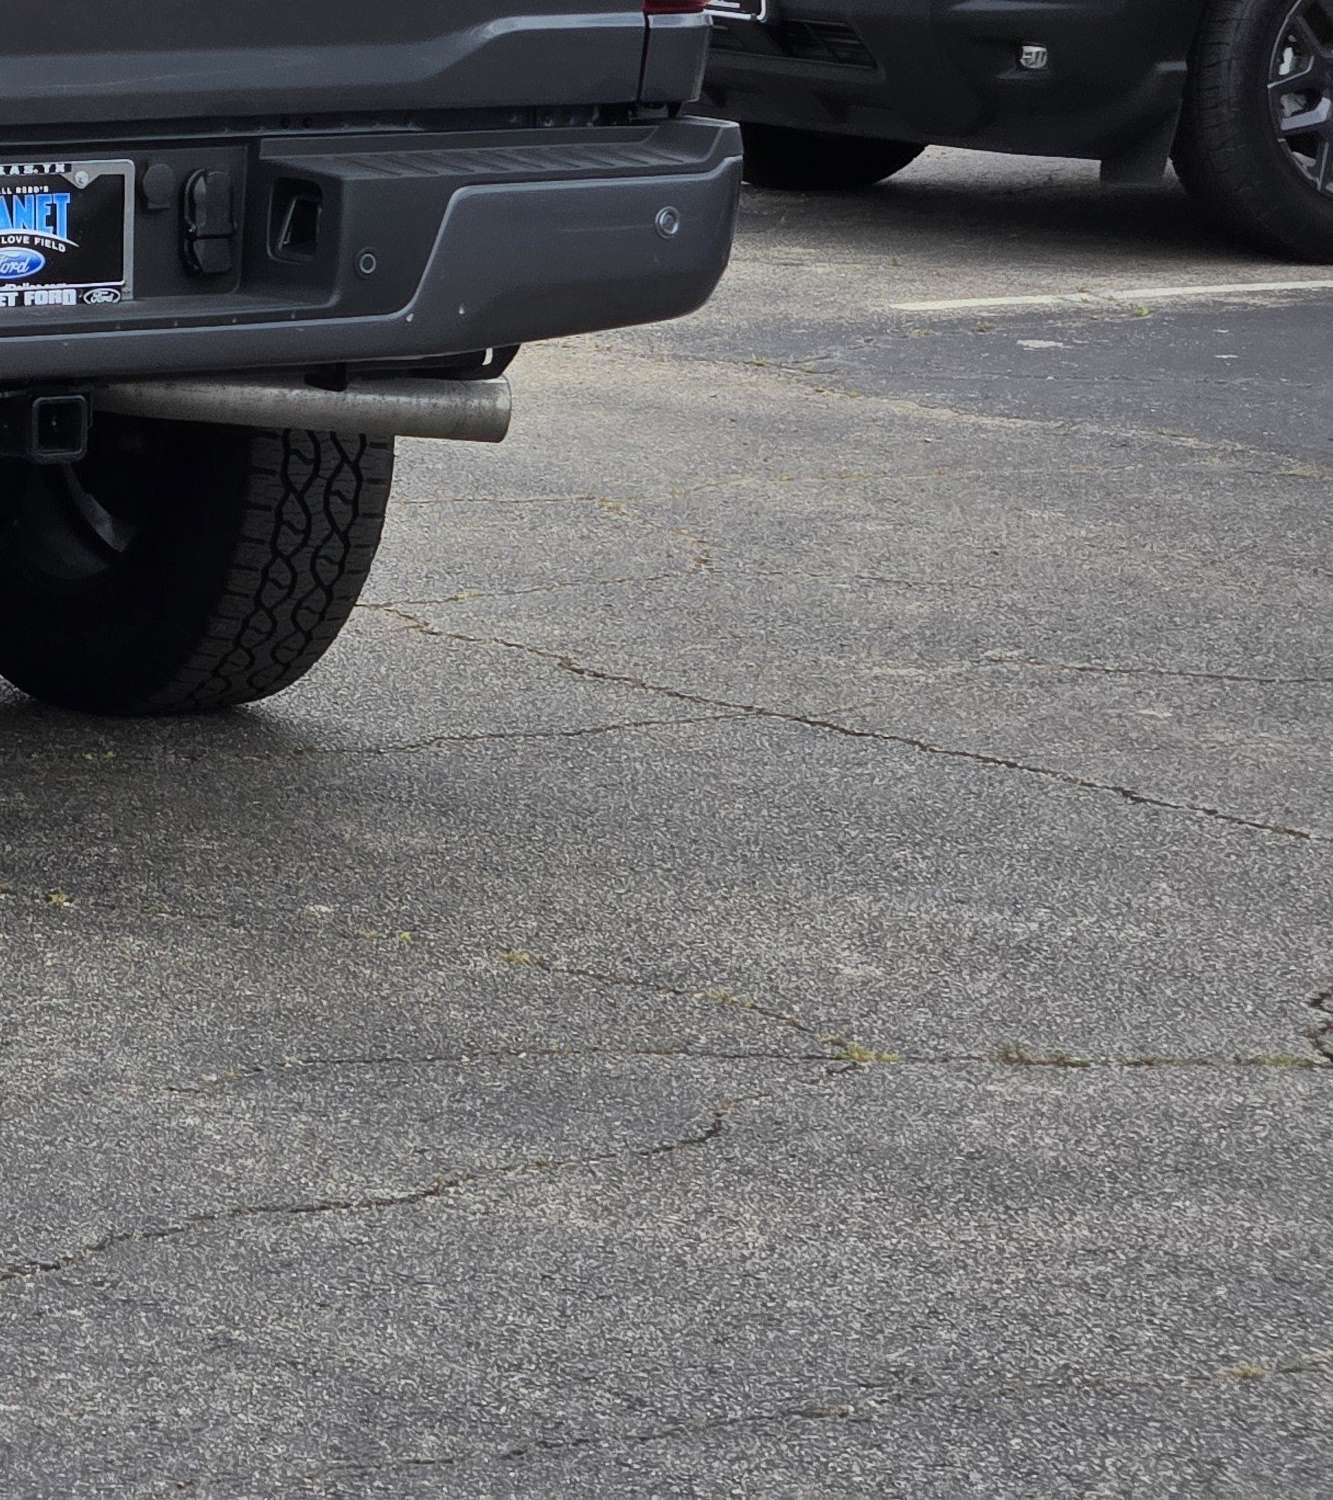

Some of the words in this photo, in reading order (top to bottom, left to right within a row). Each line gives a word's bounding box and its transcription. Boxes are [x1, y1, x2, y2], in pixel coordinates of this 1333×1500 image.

[0, 235, 30, 245] LOVE
[34, 237, 66, 253] FIELD
[23, 288, 77, 306] FORD
